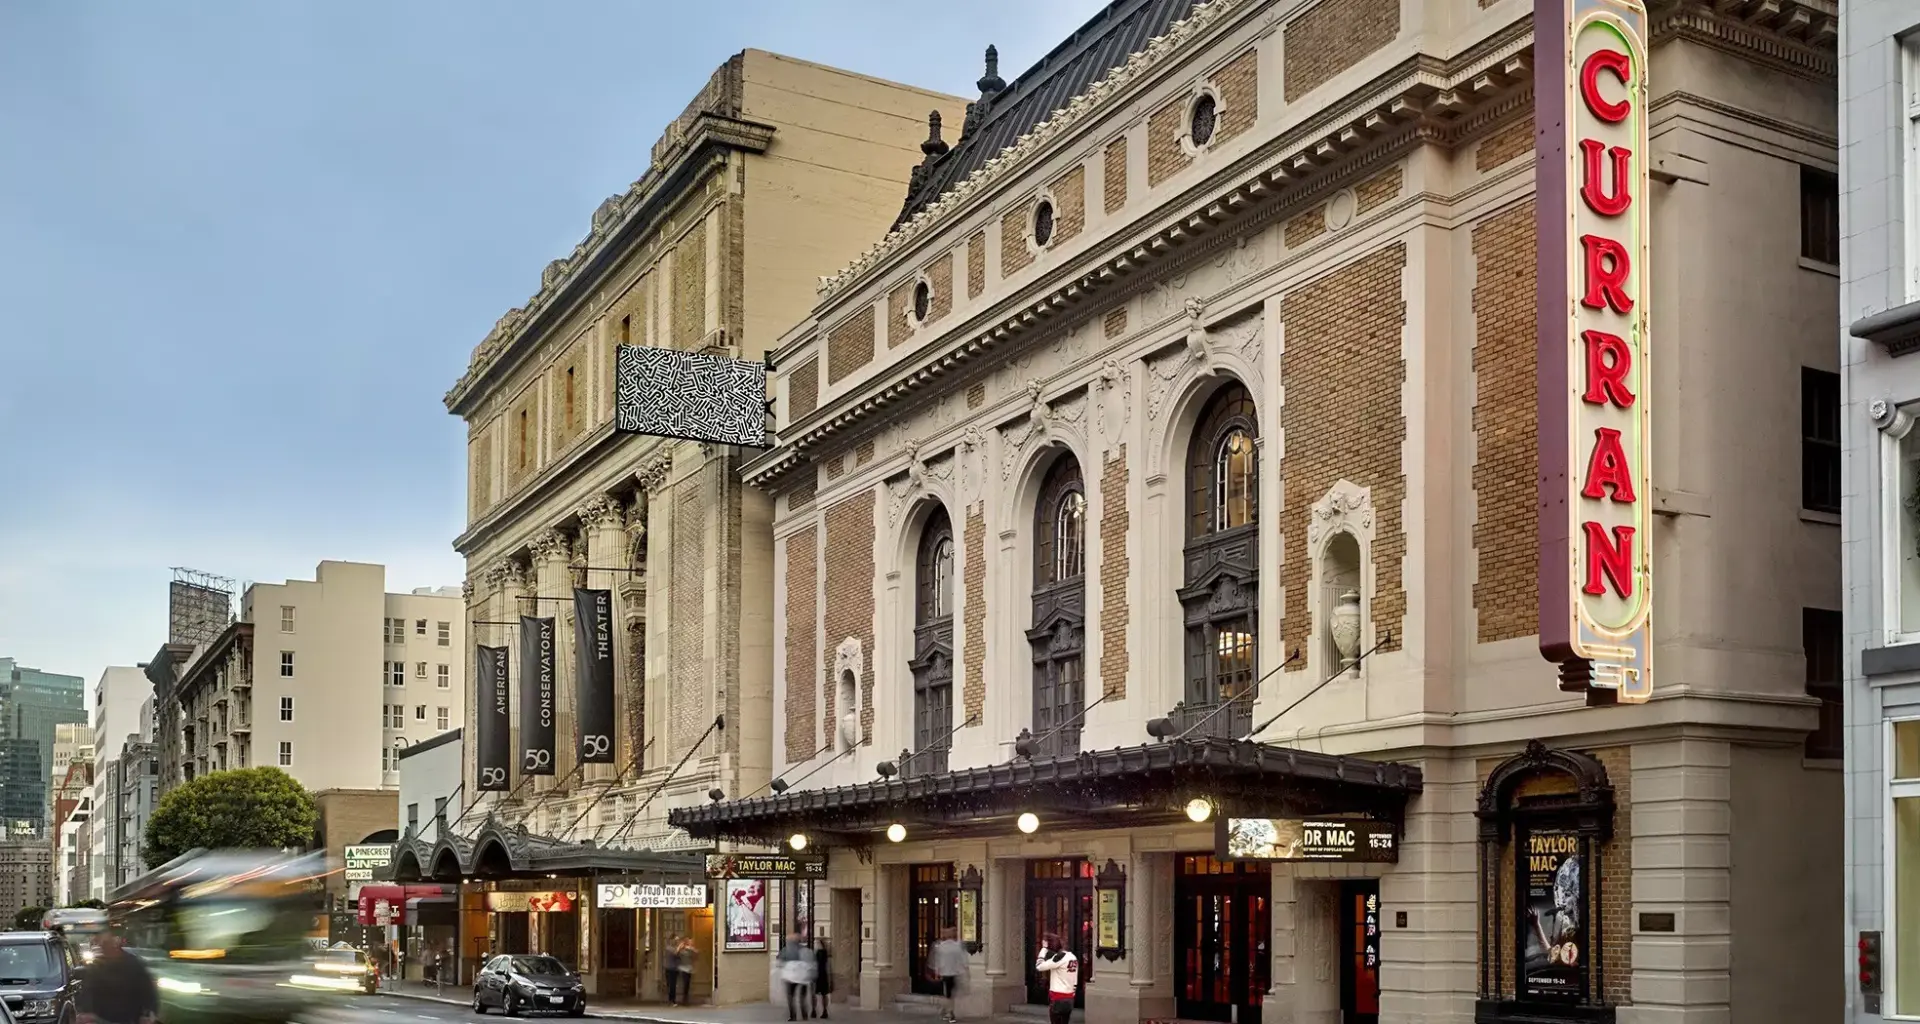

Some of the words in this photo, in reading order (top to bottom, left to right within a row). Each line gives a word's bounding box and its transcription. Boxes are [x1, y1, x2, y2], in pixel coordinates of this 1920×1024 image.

[1579, 48, 1637, 599] CURRAN
[598, 595, 607, 660] THEATER
[497, 651, 506, 715] AMERICAN
[541, 622, 550, 728] CONSERVATORY
[584, 735, 610, 758] 50
[525, 749, 550, 770] 50
[483, 767, 506, 787] 50
[17, 820, 30, 828] THE
[1326, 829, 1356, 846] MAC
[1369, 839, 1392, 848] 15-24
[1529, 836, 1576, 854] TAYLOR
[355, 847, 390, 856] PINECREST
[738, 860, 773, 871] TAYLOR
[775, 860, 796, 871] MAC
[1530, 855, 1558, 872] MAC
[604, 885, 624, 902] 50
